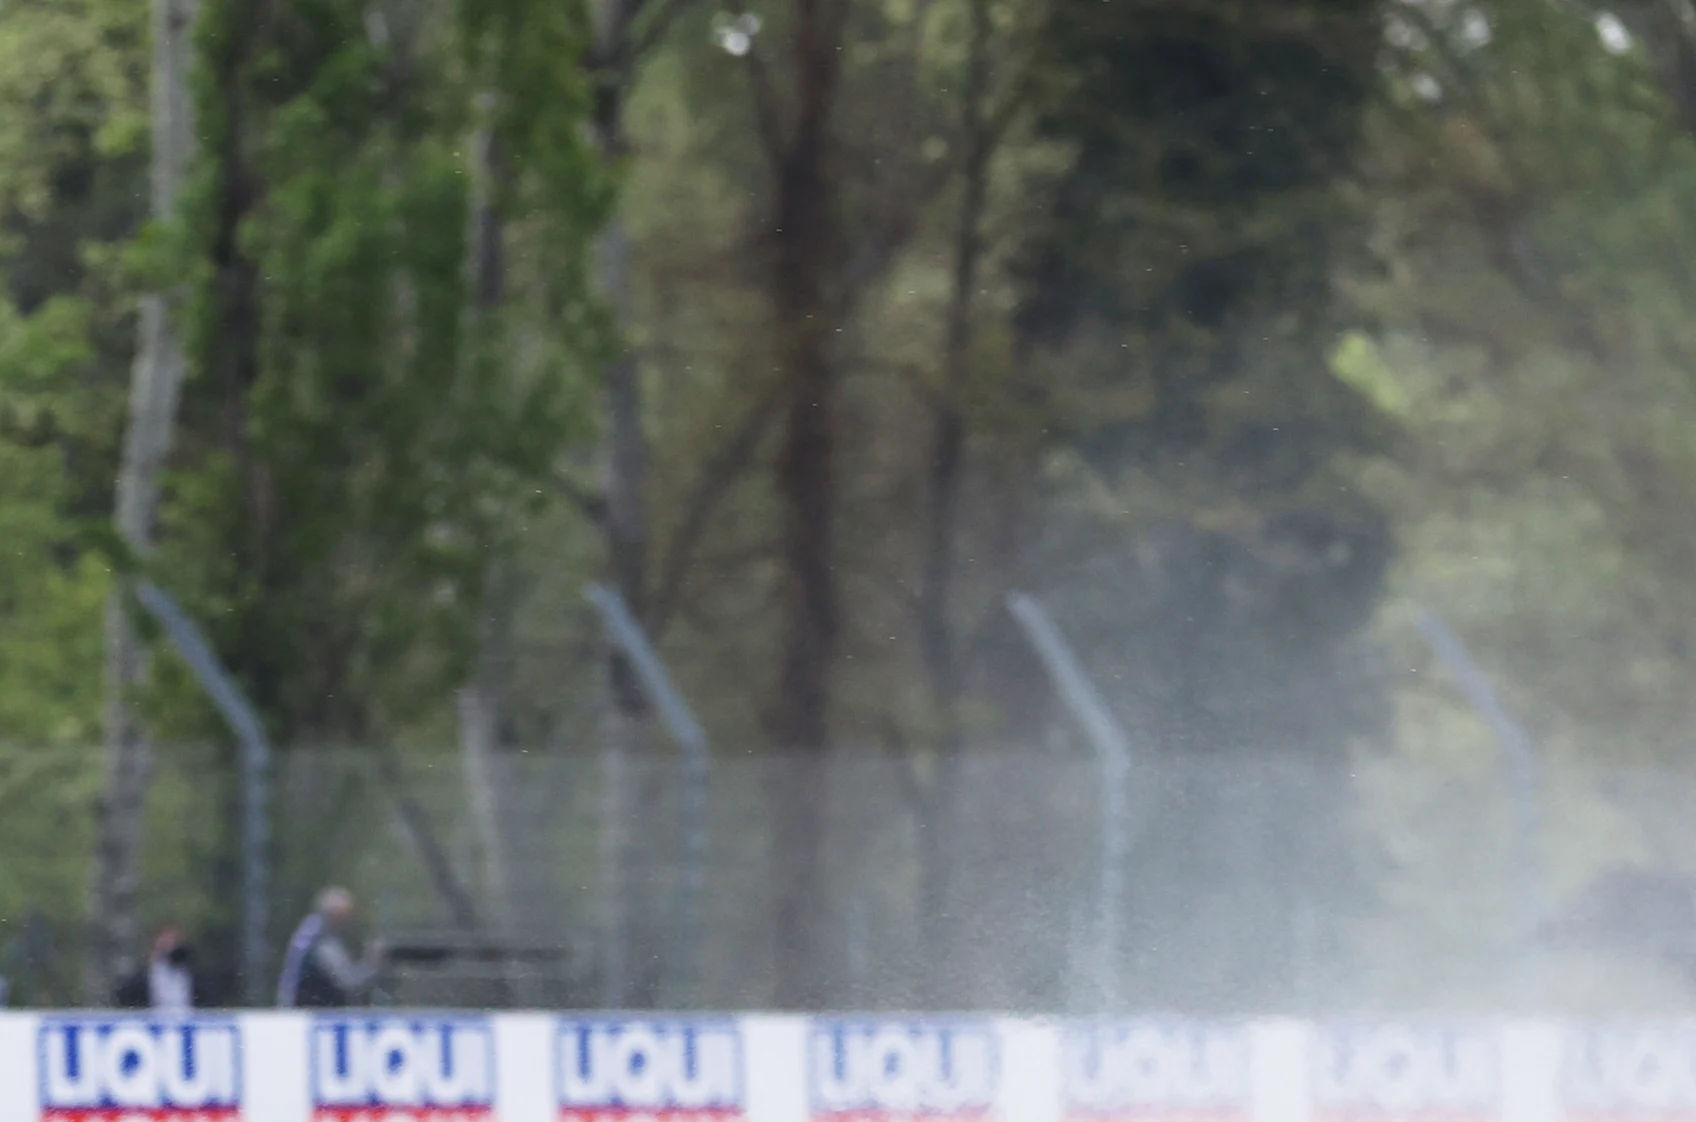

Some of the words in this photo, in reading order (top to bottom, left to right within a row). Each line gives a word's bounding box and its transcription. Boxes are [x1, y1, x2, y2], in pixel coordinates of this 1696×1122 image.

[45, 1023, 236, 1106] LIQUI
[315, 1022, 492, 1106] LIQUI
[560, 1023, 740, 1106] LIQUI
[813, 1024, 993, 1106] LIQUI
